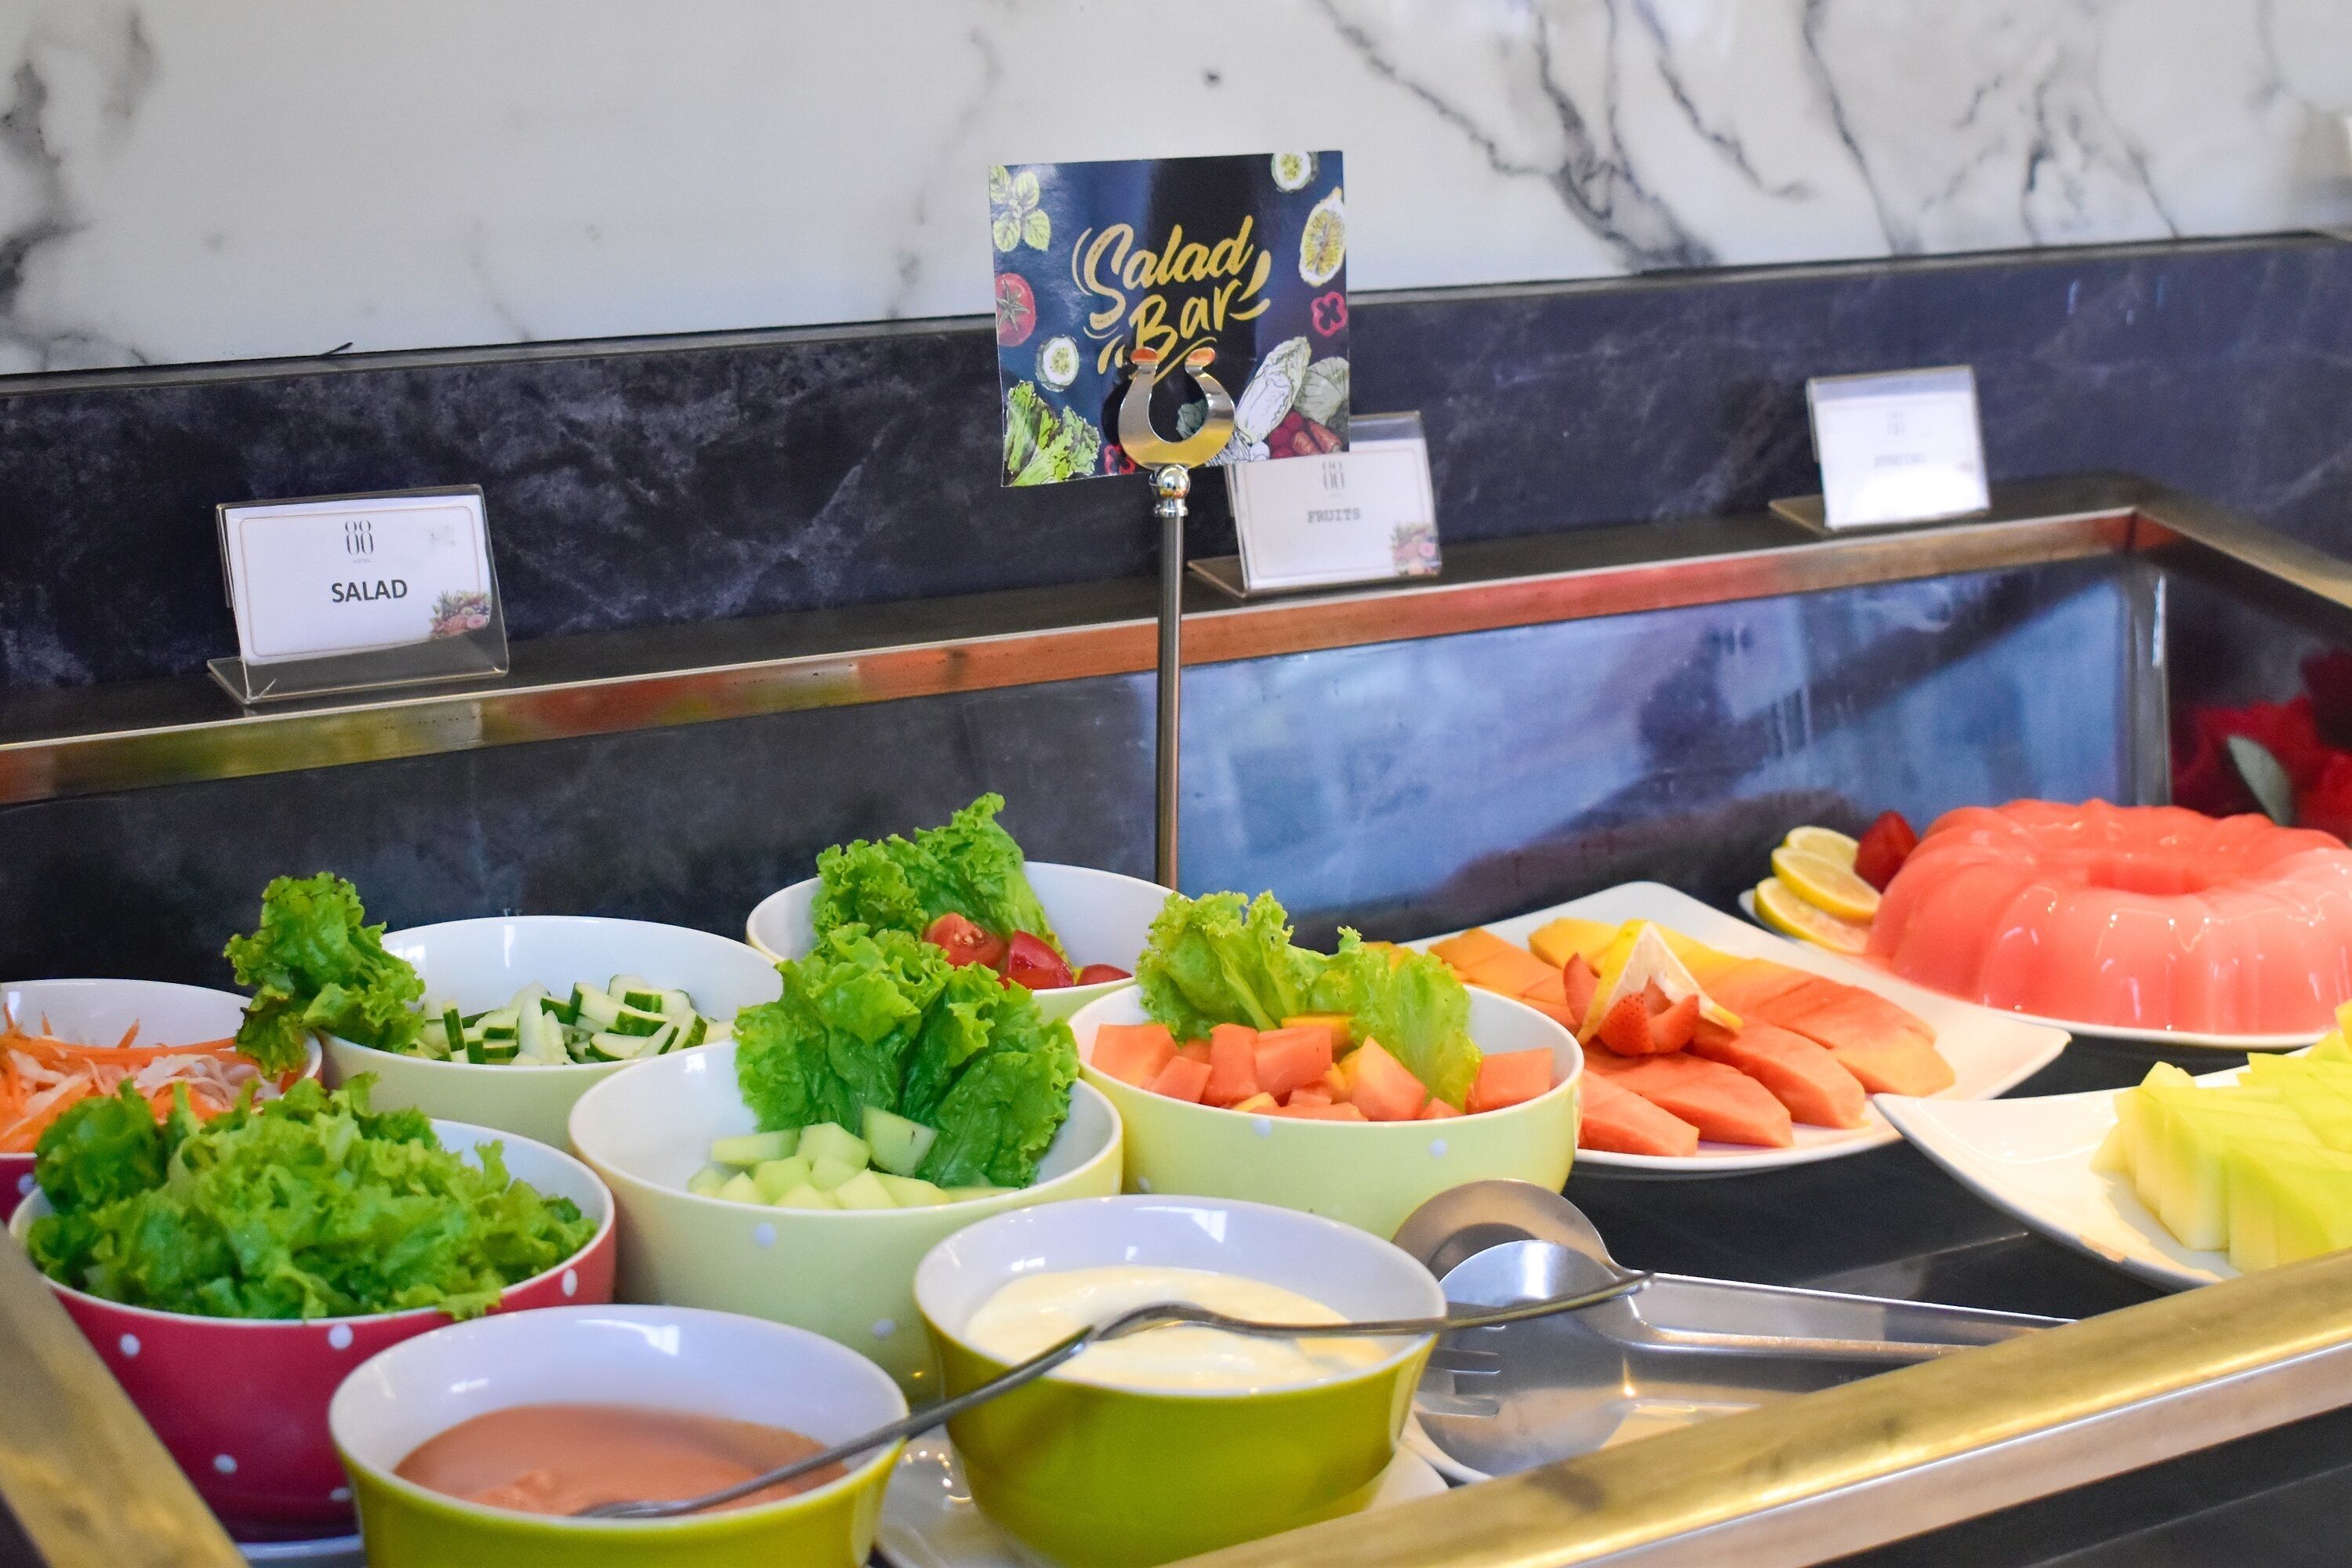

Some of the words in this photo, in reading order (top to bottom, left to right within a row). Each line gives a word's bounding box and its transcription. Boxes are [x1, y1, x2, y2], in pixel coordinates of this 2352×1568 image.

[1083, 215, 1254, 329] Salad
[1128, 279, 1243, 363] Bar
[1307, 507, 1361, 524] FRUITS
[345, 520, 374, 555] 88
[331, 579, 408, 603] SALAD
